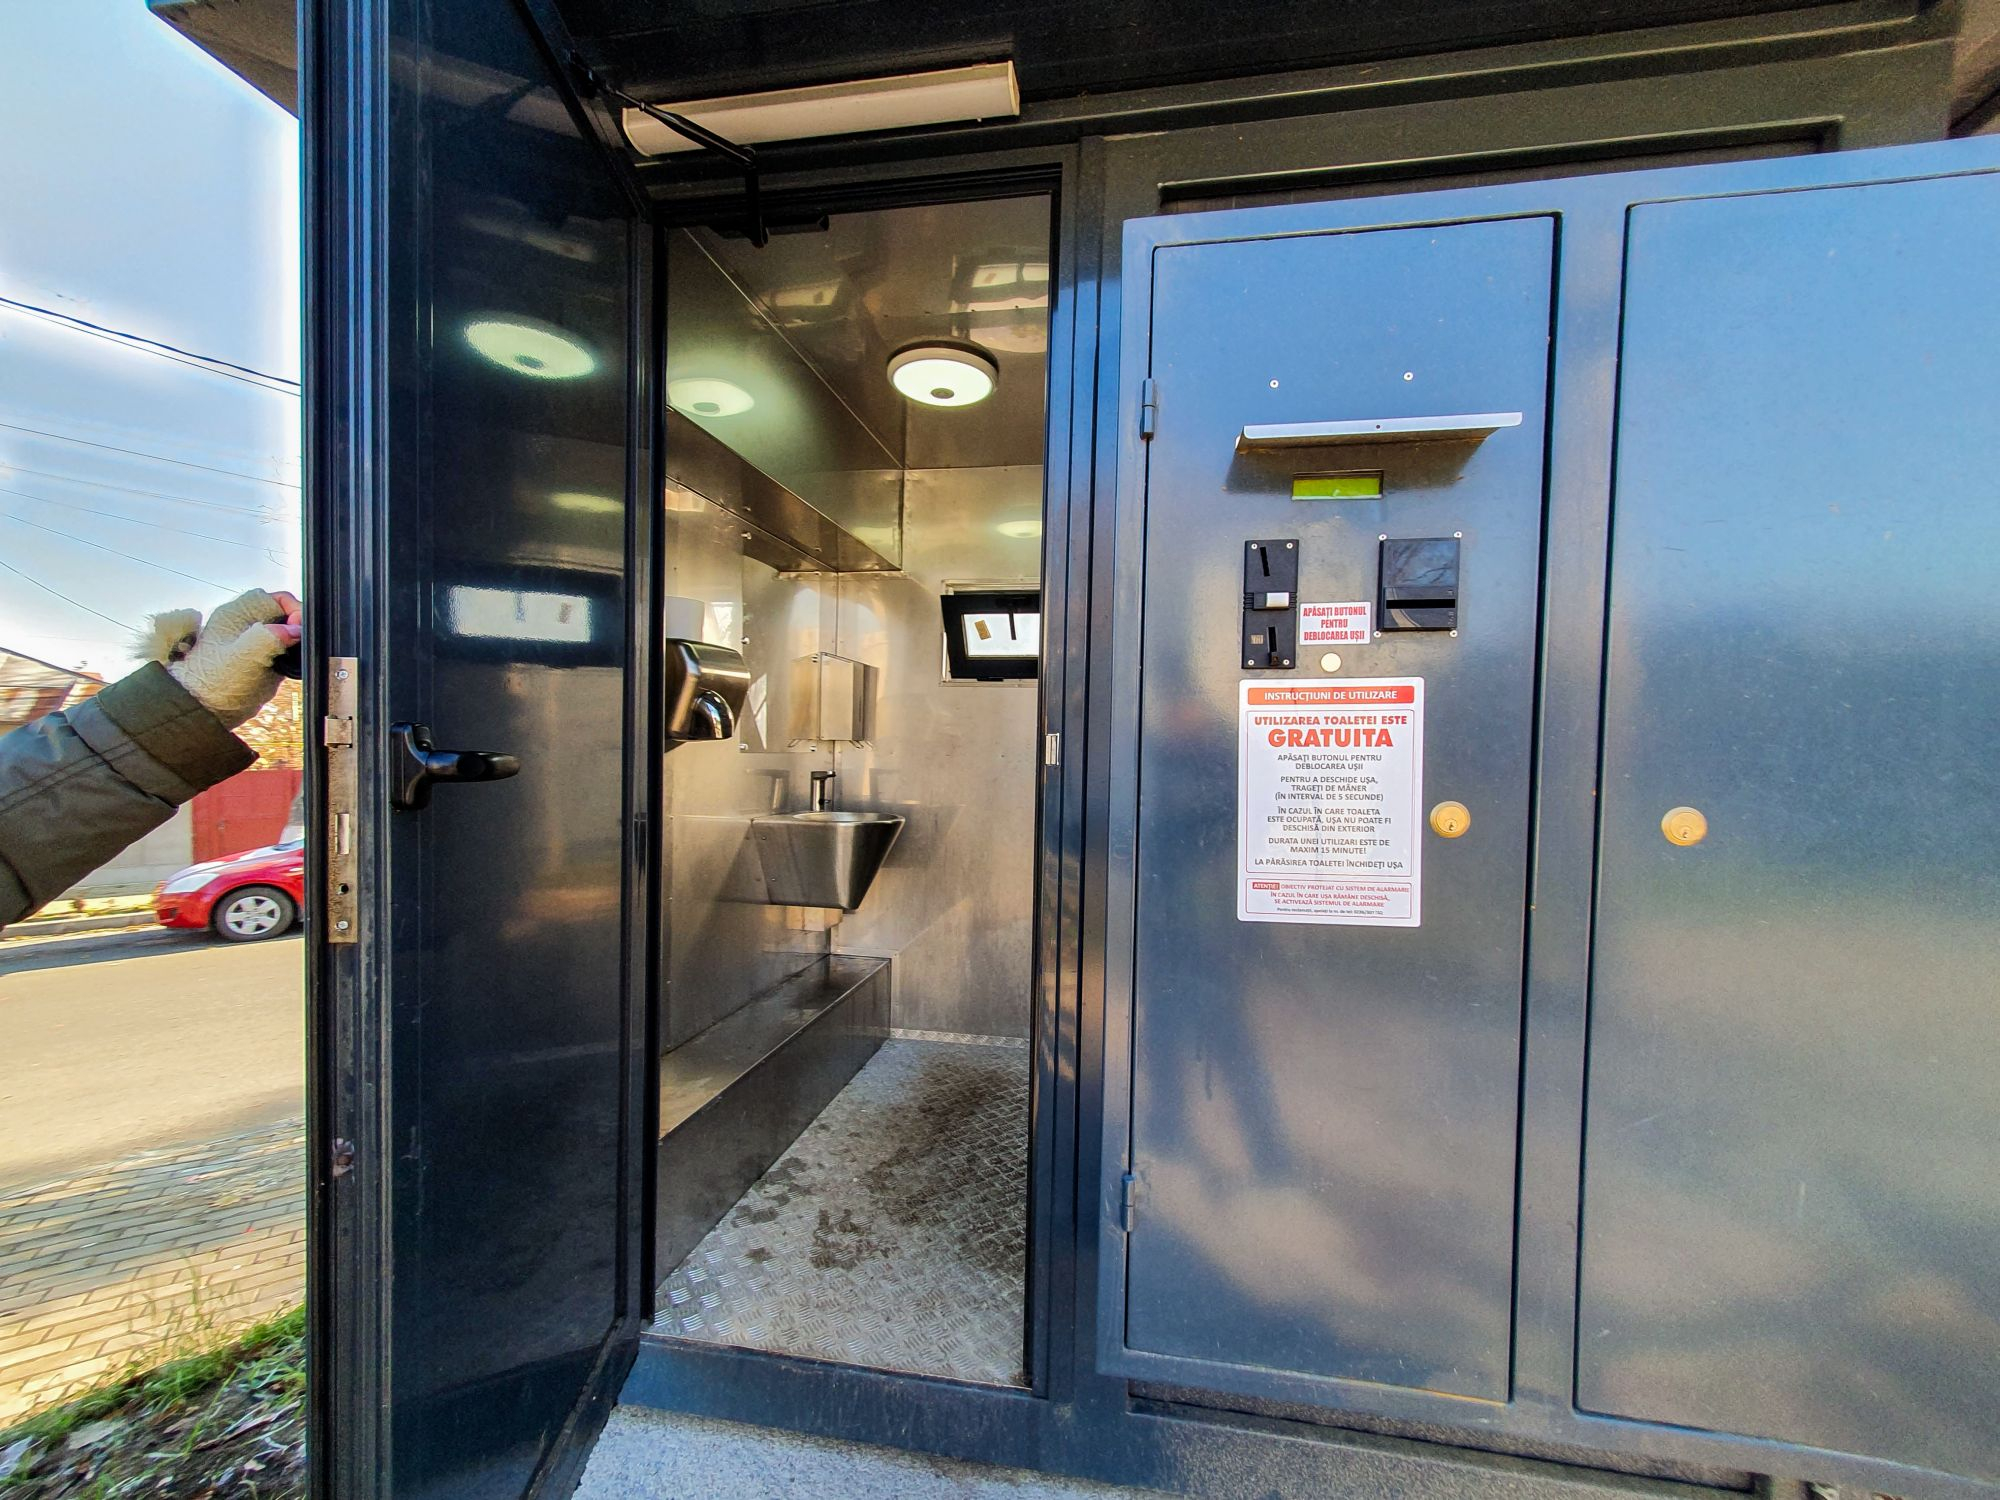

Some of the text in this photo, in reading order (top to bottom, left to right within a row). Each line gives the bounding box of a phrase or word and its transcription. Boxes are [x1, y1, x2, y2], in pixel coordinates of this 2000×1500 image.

[1303, 606, 1367, 618] APĂSAȚI BUTONUL
[1321, 619, 1348, 629] PENTRU
[1304, 630, 1365, 642] DEBLOCAREA UȘII
[1264, 691, 1397, 702] INSTRUCȚIUNI DE UTILIZARE
[1255, 716, 1407, 726] UTILIZAREA TOALETEI ESTE
[1268, 728, 1393, 747] GRATUITA
[1312, 754, 1349, 762] BUTONUL
[1351, 754, 1382, 762] PENTRU
[1275, 792, 1286, 801] (ÎN
[1345, 794, 1384, 802] SECUNDE)
[1278, 806, 1287, 814] ÎN
[1314, 807, 1323, 815] ÎN
[1283, 824, 1319, 832] DESCHISĂ
[1309, 859, 1344, 867] TOALETEI
